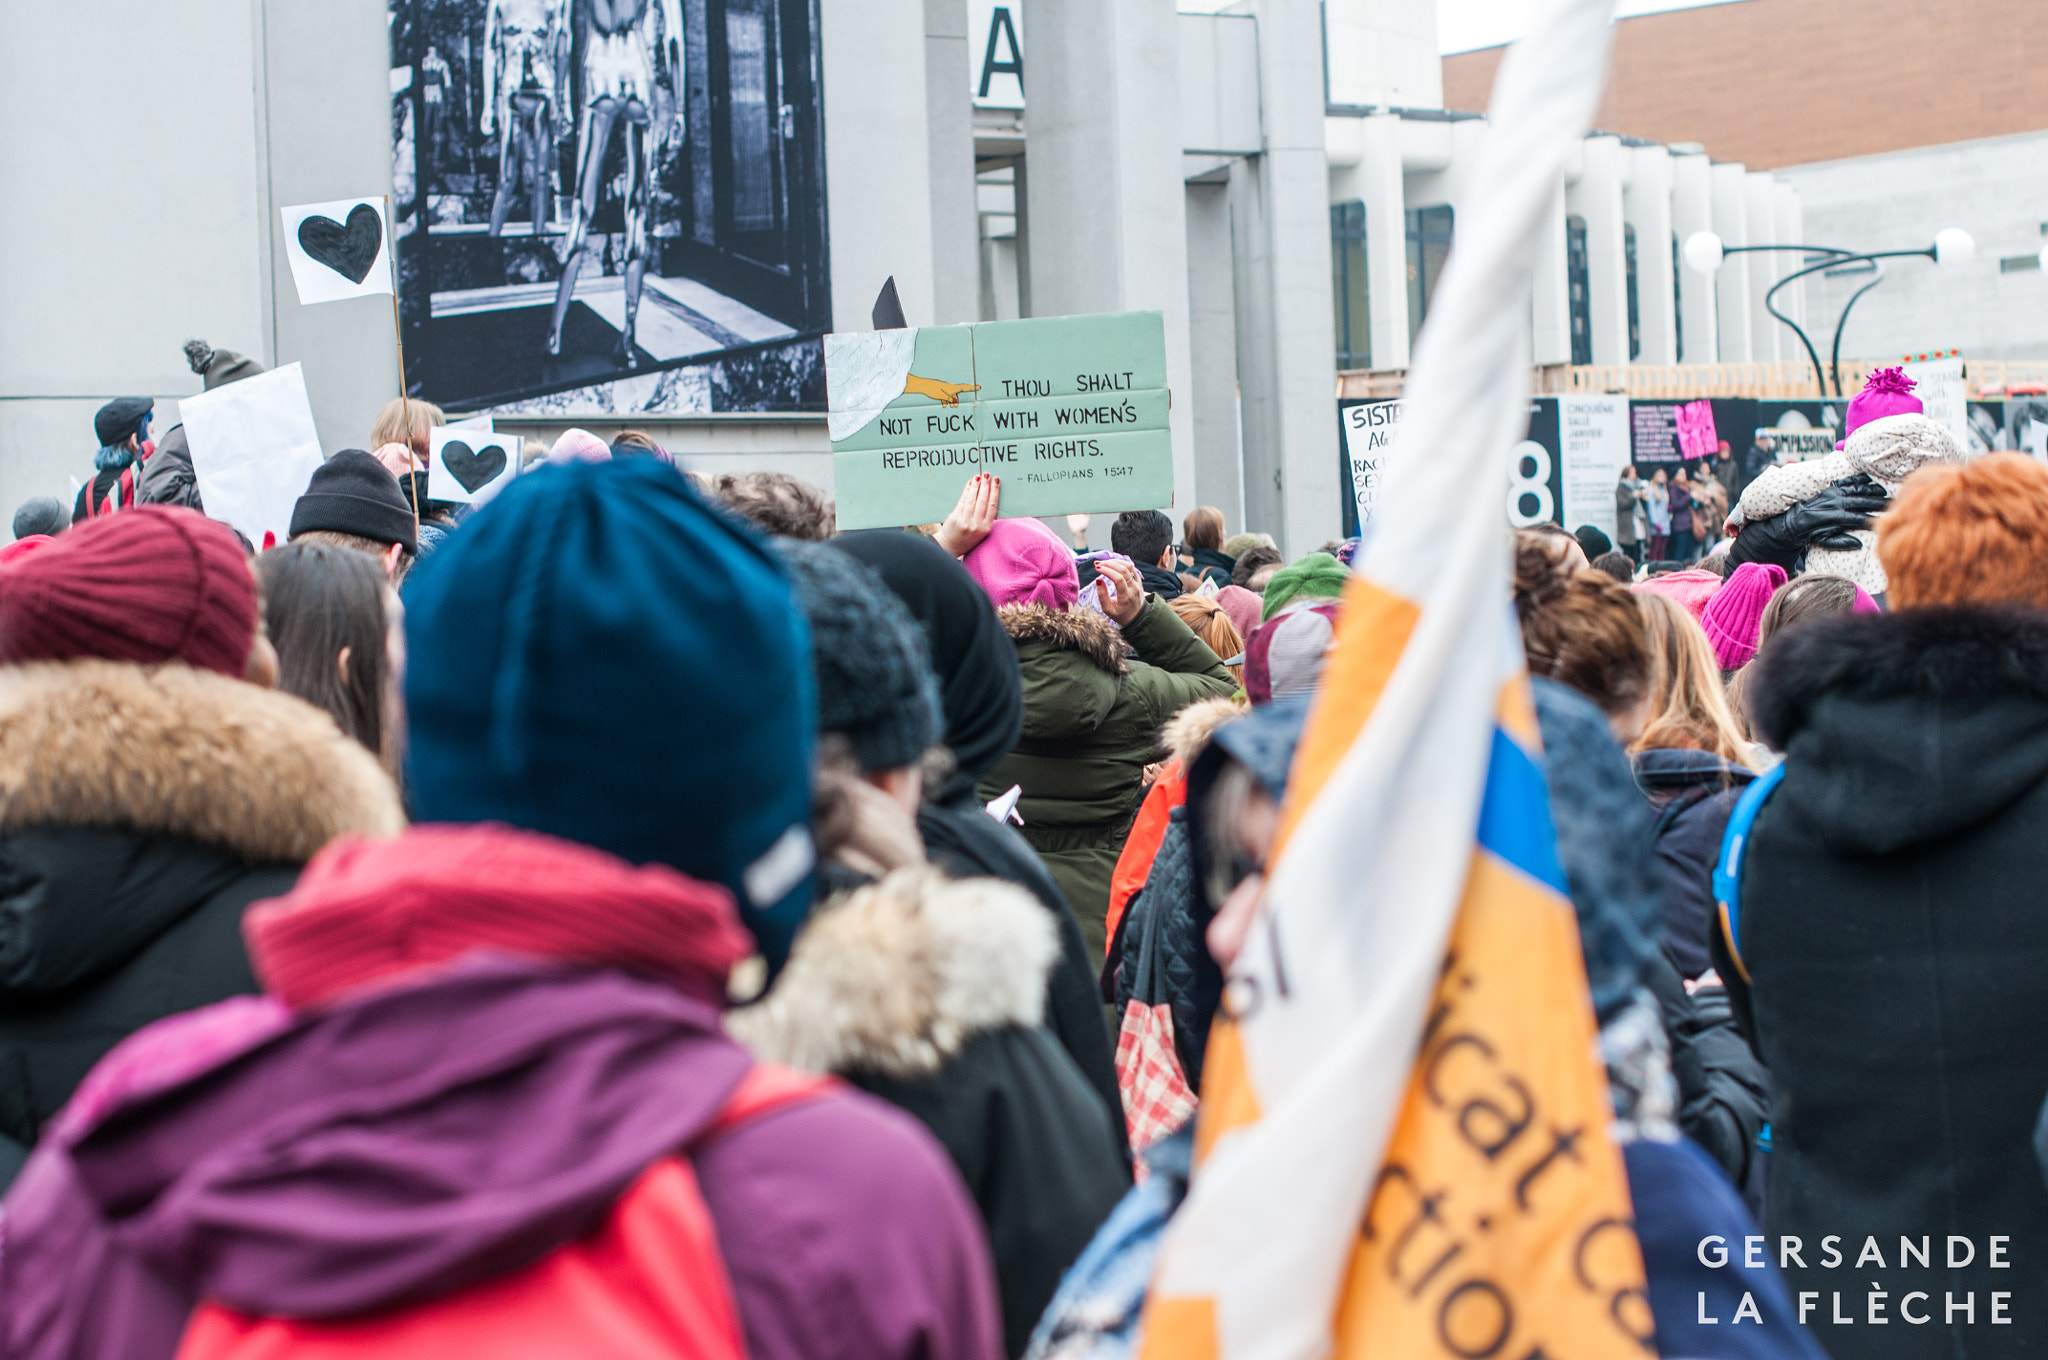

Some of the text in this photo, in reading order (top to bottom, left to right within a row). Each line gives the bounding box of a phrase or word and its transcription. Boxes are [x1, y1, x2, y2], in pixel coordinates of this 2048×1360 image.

[978, 7, 1025, 98] A
[1001, 372, 1134, 397] THOU SHALT
[880, 398, 1138, 436] NOT FUCK WITH WOMEN'S
[883, 440, 1103, 469] REPRODUCTIVE RIGHTS.
[1028, 469, 1094, 483] FALLOPIANS
